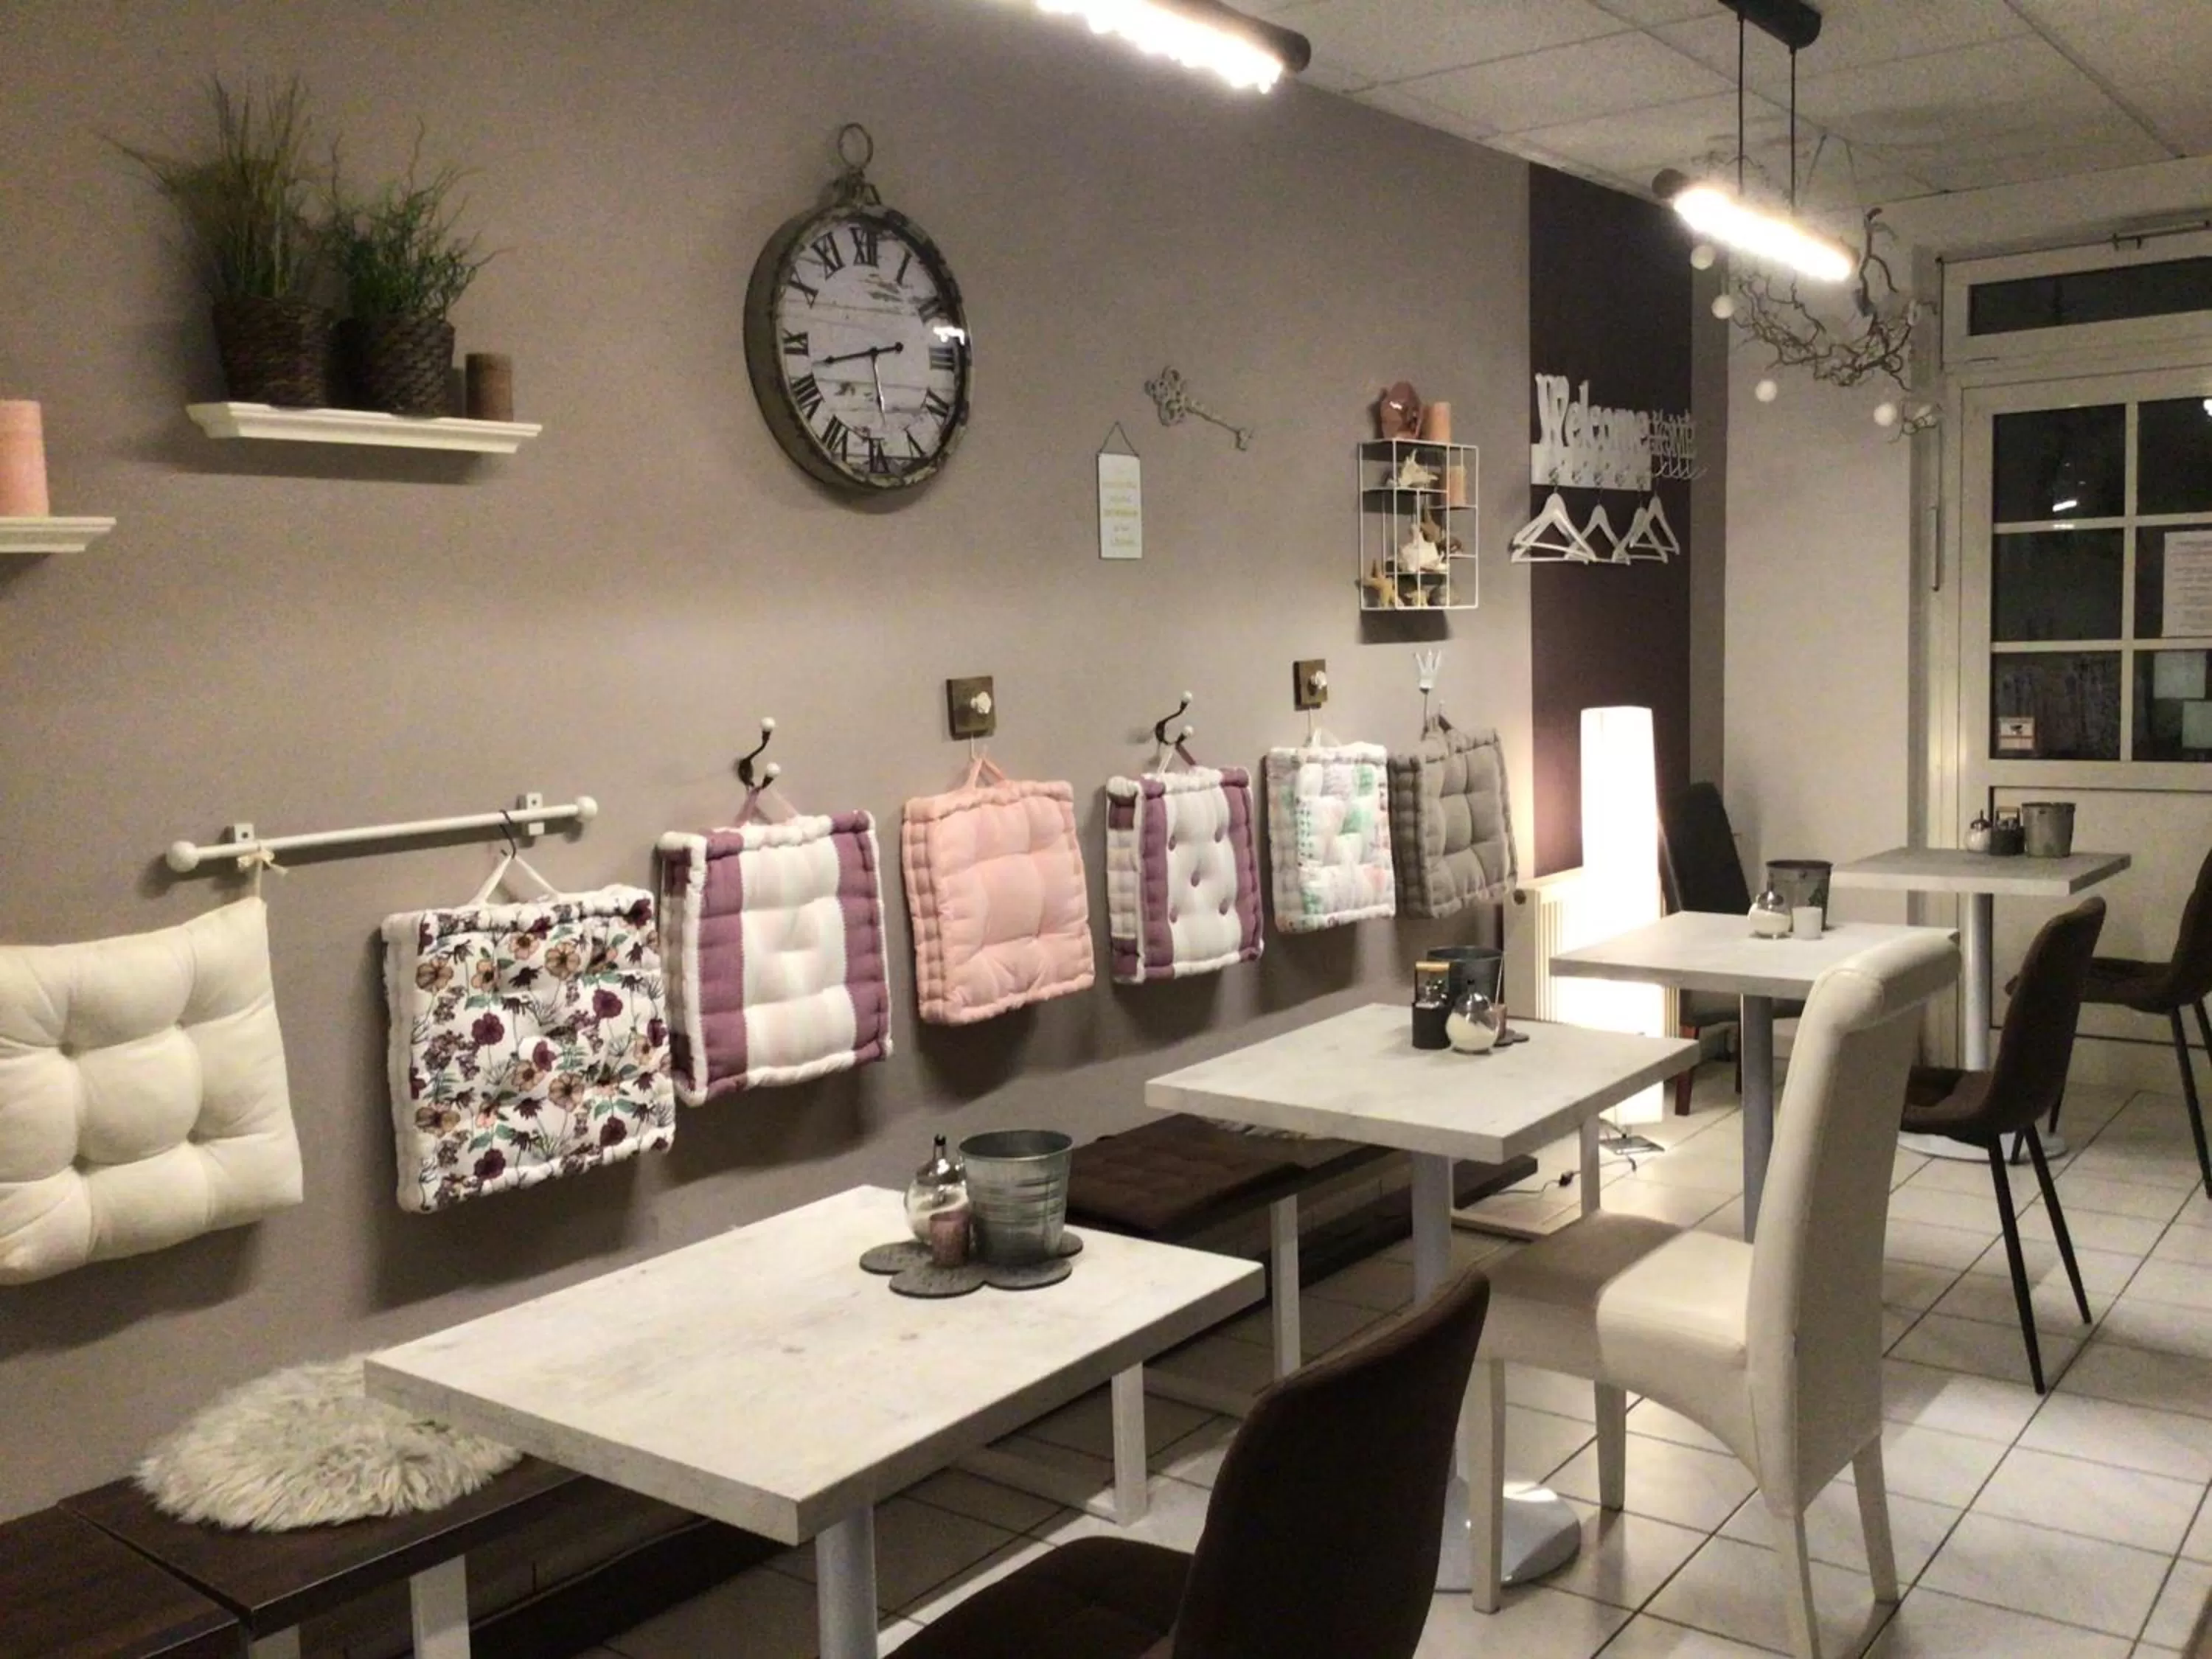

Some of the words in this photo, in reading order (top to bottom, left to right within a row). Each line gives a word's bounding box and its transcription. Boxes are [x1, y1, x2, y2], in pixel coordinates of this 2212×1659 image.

[810, 231, 846, 281] XI
[849, 226, 880, 268] XII
[788, 265, 819, 310] X
[782, 327, 810, 358] IX
